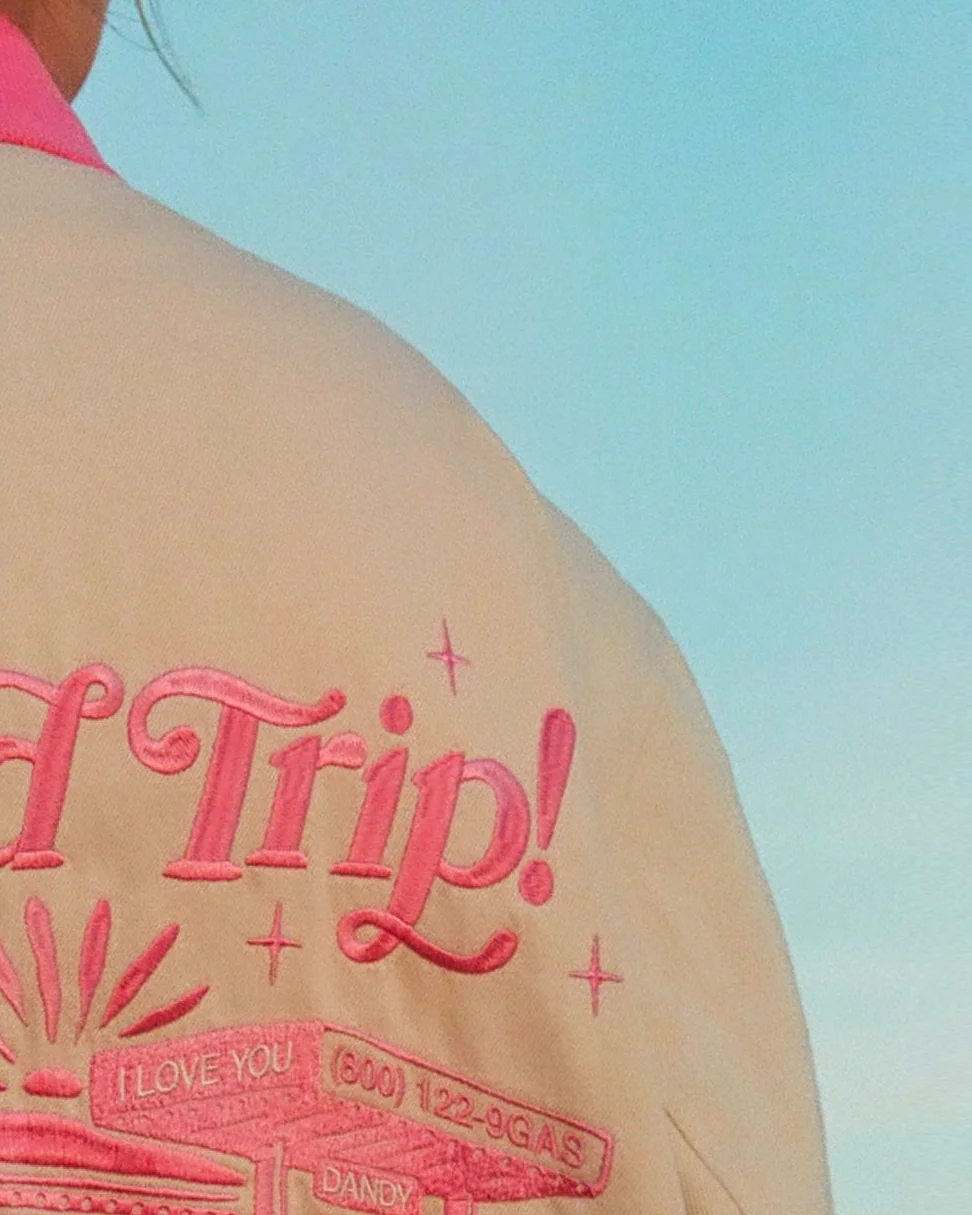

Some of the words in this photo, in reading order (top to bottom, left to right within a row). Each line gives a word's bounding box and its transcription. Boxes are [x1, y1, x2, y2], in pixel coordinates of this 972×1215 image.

[128, 665, 577, 975] Trip!
[117, 1069, 126, 1102] I
[135, 1052, 222, 1098] LOVE
[233, 1041, 294, 1081] YOU
[416, 1077, 587, 1171] 122-9GAS
[320, 1165, 415, 1211] DANDY
